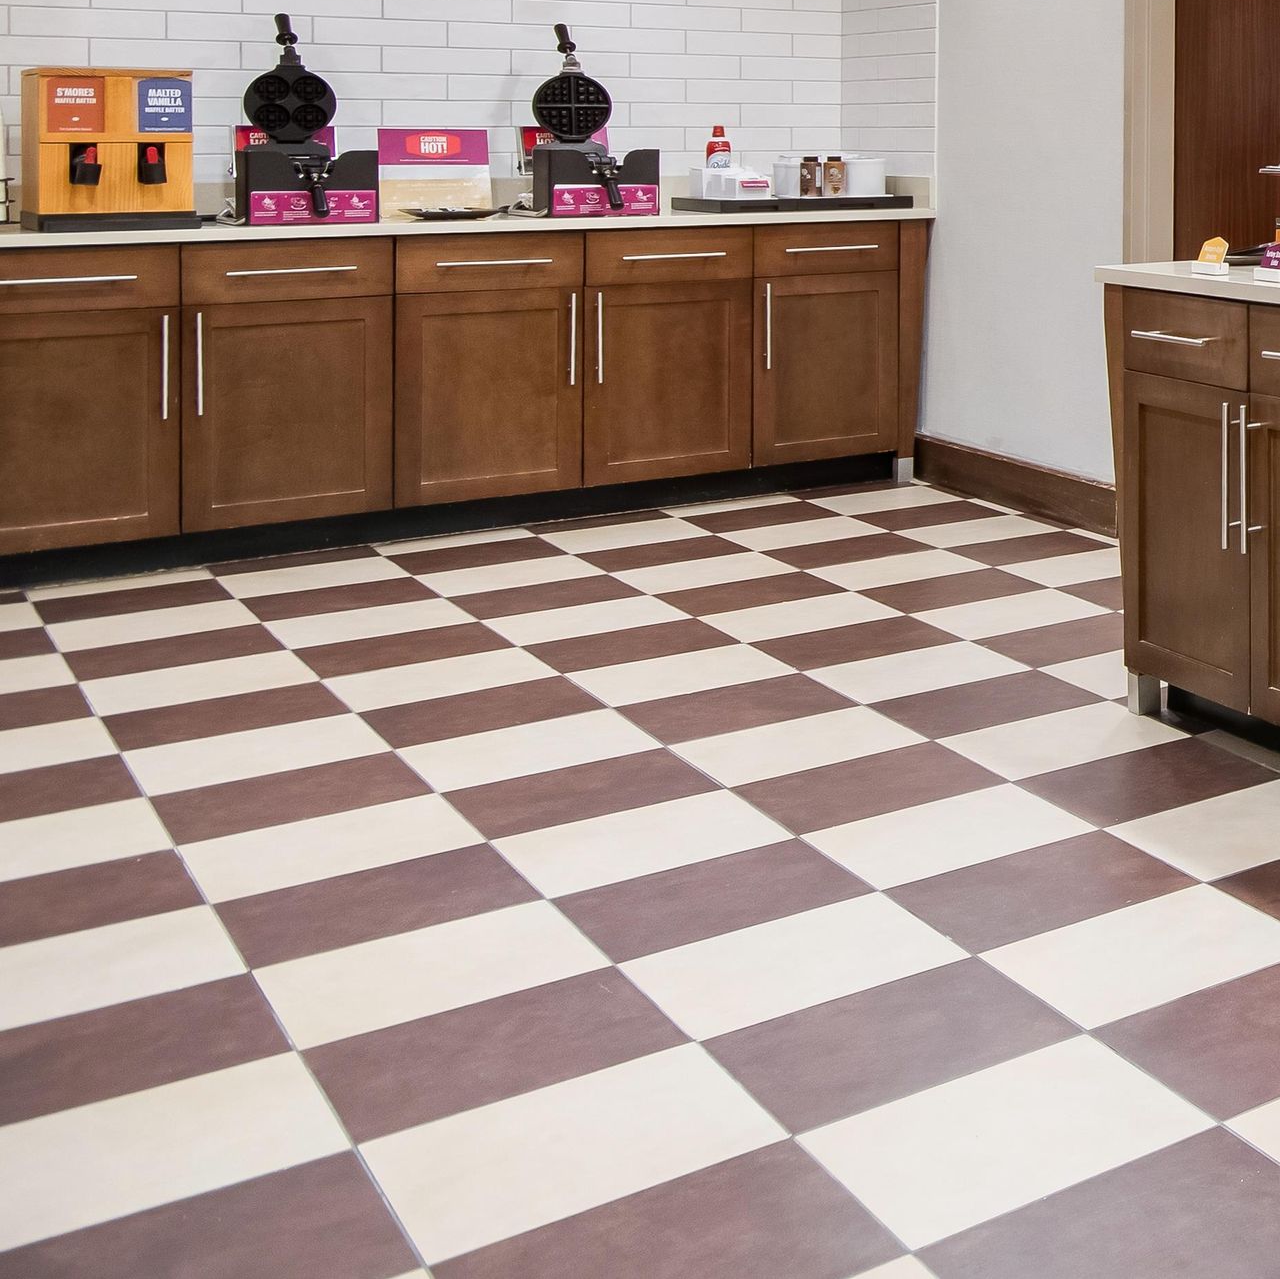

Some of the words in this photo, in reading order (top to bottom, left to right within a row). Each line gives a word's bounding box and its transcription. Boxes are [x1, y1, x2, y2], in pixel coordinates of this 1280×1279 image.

[148, 88, 182, 97] MALTED
[147, 97, 183, 106] VANILLA
[420, 142, 448, 154] HOT!
